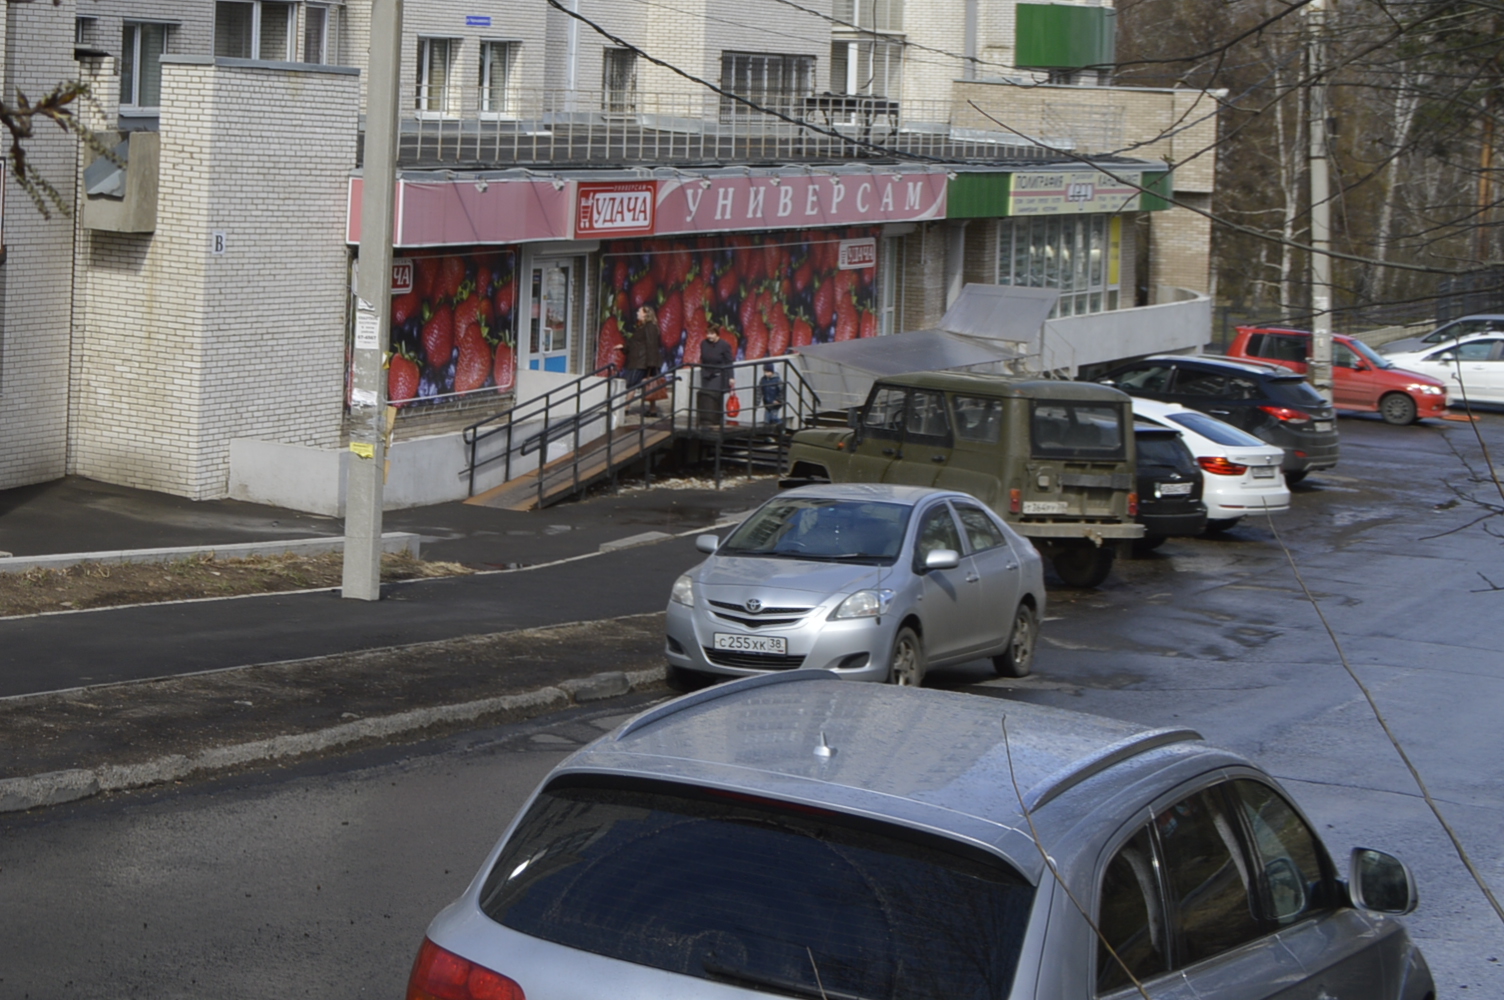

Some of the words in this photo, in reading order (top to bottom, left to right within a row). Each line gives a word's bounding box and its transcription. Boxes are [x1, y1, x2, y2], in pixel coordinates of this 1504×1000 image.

[594, 196, 648, 225] УДАЧА
[686, 181, 923, 222] УНИВЕРСАМ
[848, 245, 874, 263] УДАЧА
[719, 636, 766, 651] С255ХК
[769, 638, 782, 649] 38
